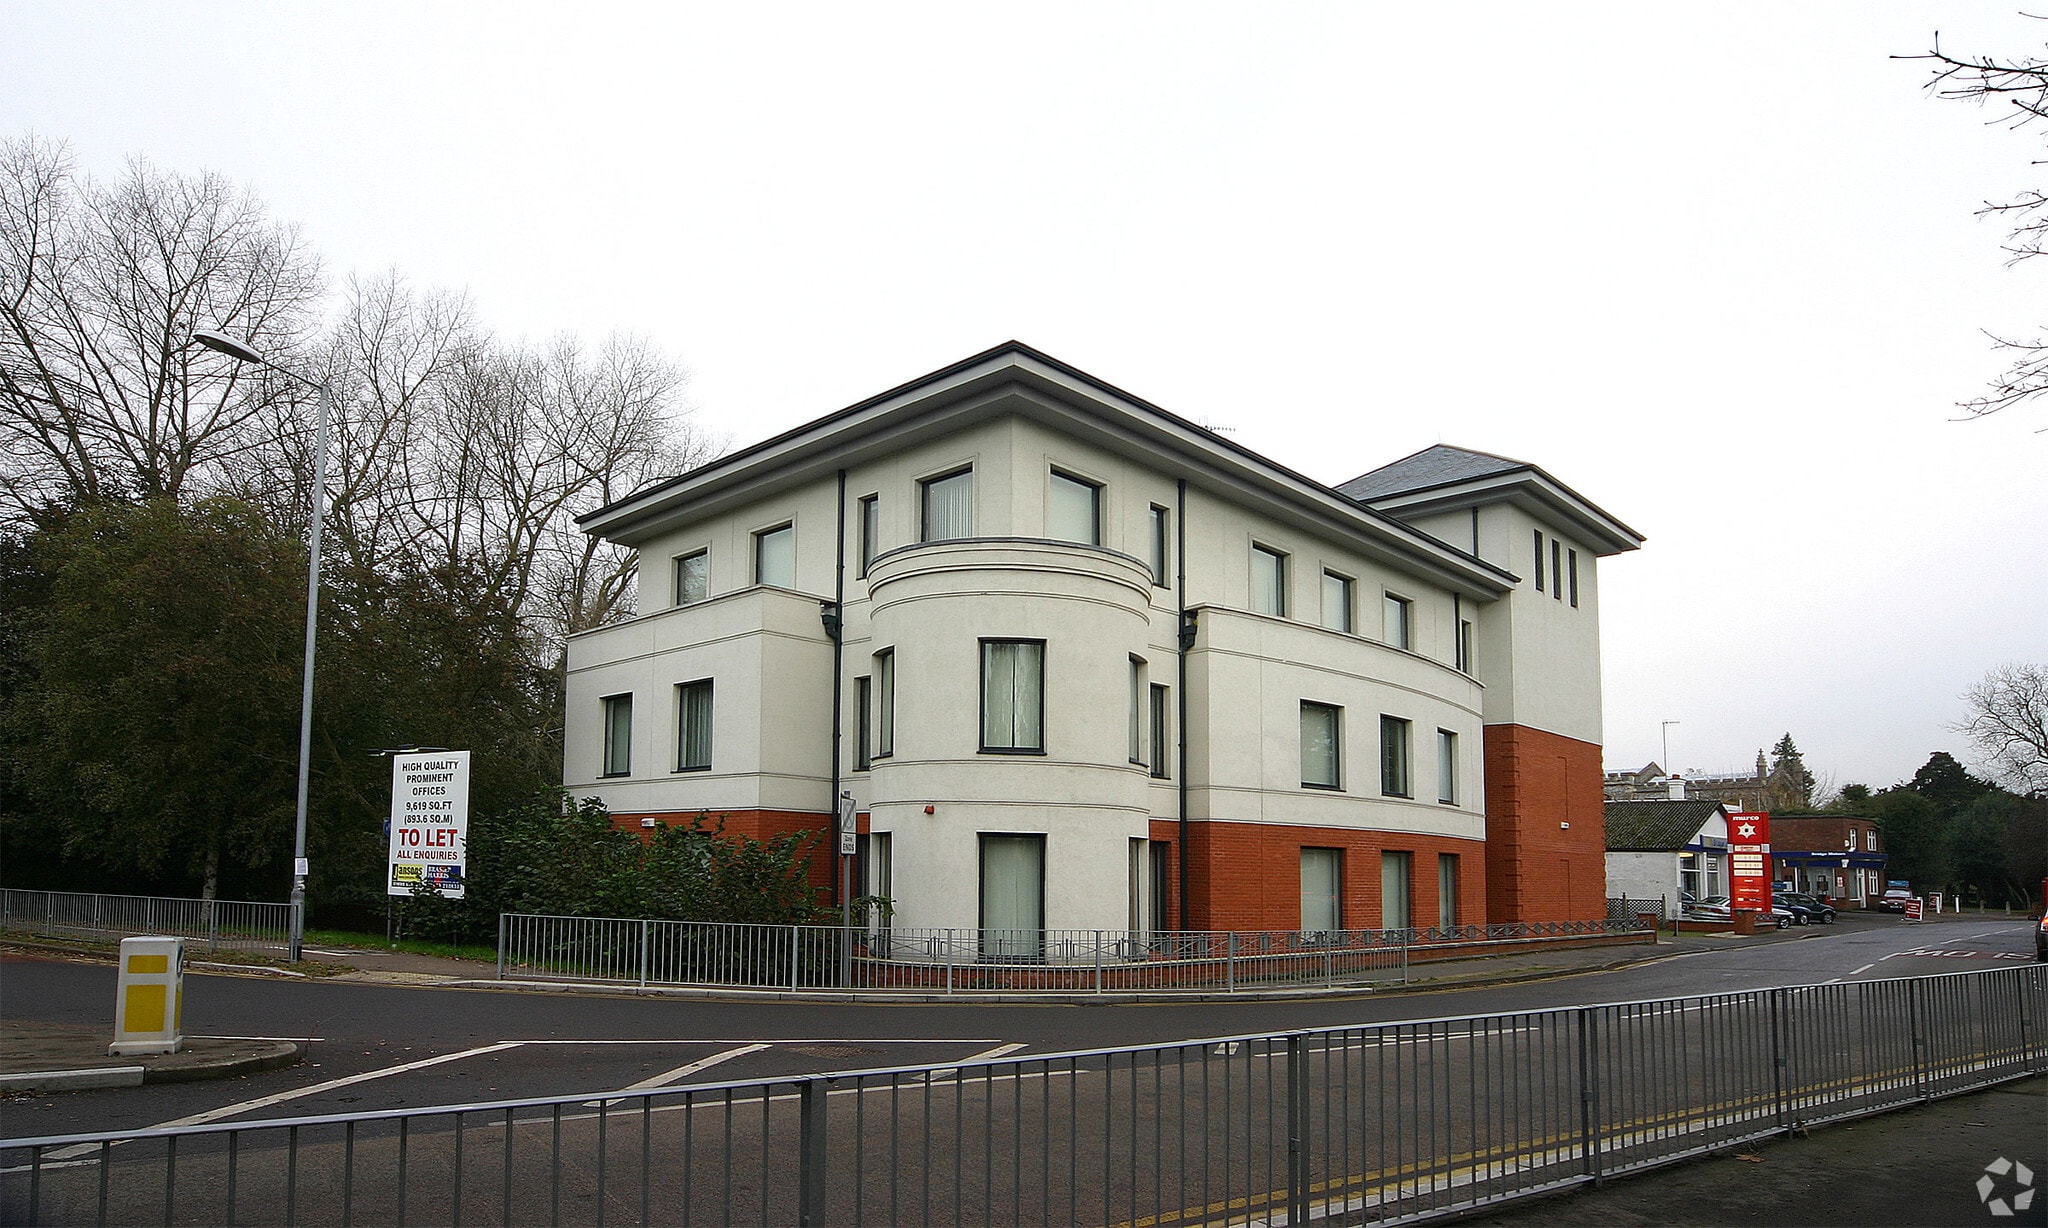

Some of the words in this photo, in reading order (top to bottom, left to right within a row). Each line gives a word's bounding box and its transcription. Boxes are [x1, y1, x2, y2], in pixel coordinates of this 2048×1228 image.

[402, 762, 422, 772] HIGH
[423, 760, 459, 771] QUALITY
[406, 772, 454, 783] PROMINENT
[412, 786, 446, 796] OFFICES
[406, 801, 427, 811] 9,619
[428, 801, 452, 811] SQ.FT
[404, 814, 428, 825] (893.6
[429, 814, 453, 825] SQ.M)
[398, 828, 420, 847] TO
[426, 828, 458, 848] LET
[843, 843, 854, 851] ENDS
[397, 850, 412, 859] ALL
[413, 850, 458, 861] ENQUIRIES
